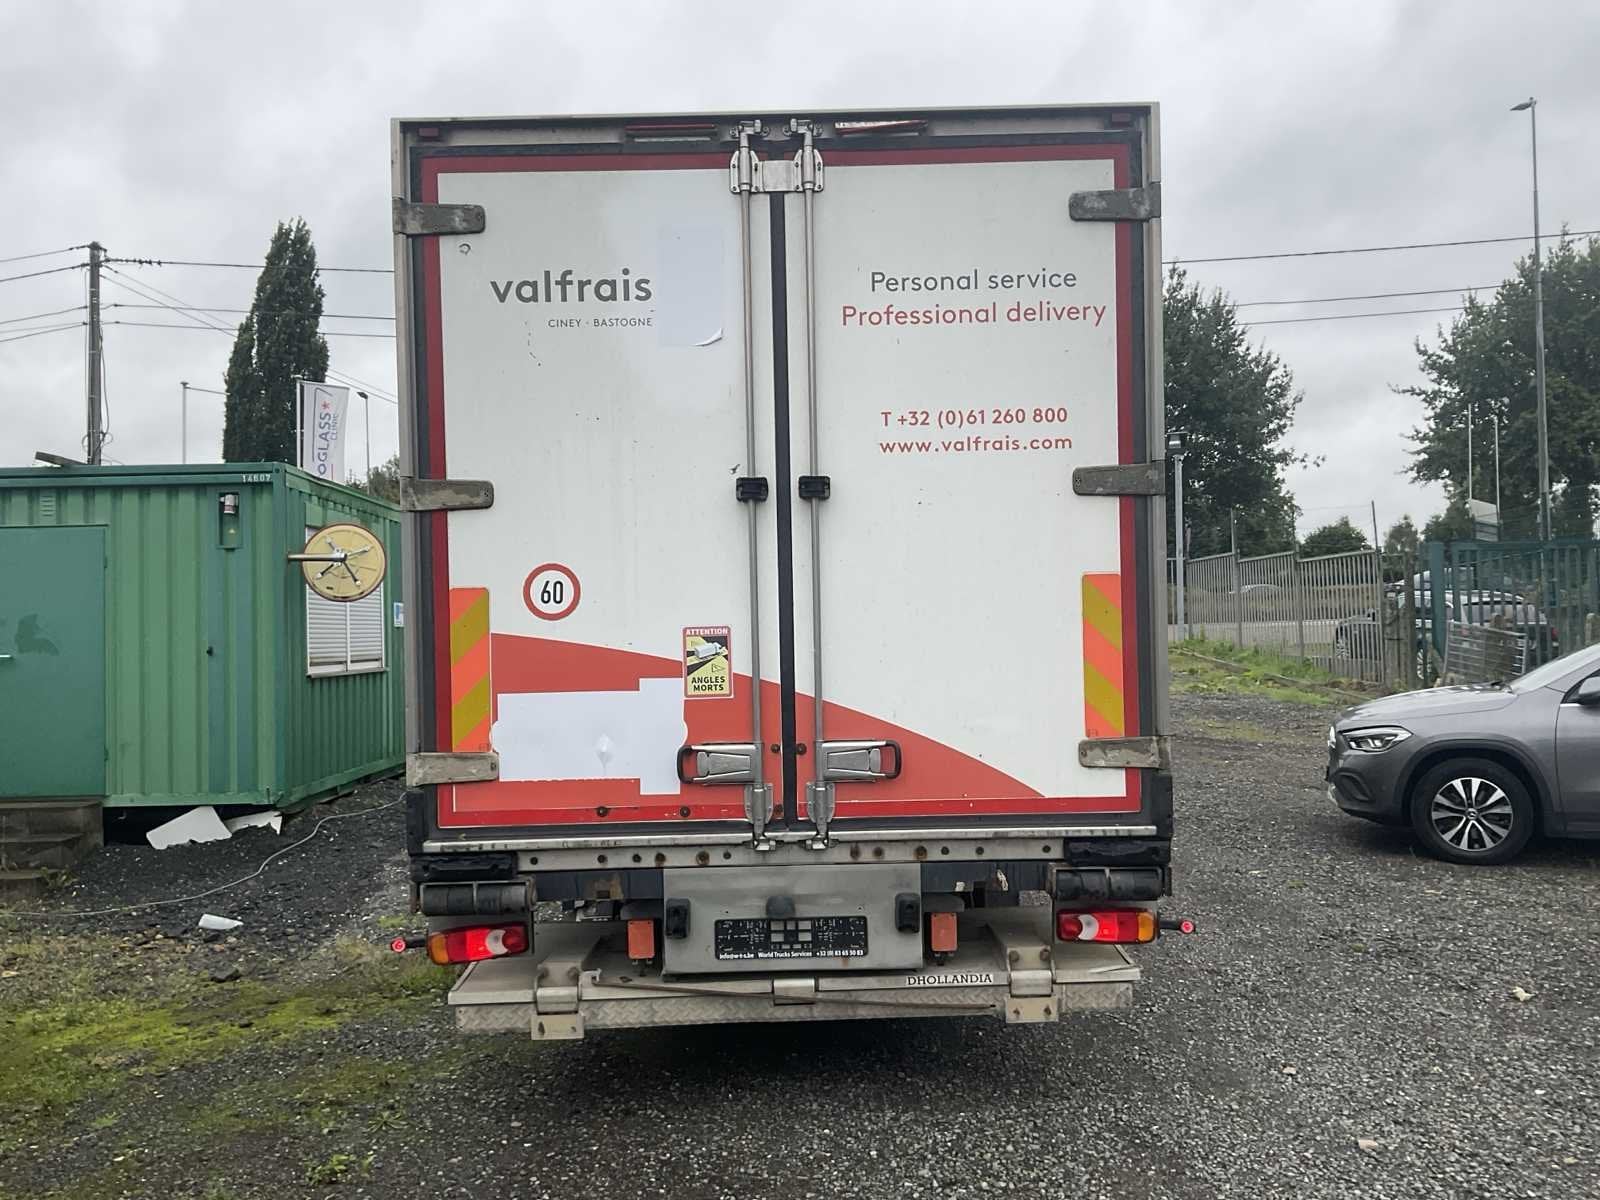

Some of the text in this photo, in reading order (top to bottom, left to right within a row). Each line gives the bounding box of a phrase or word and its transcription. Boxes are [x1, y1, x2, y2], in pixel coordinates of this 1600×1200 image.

[490, 268, 653, 303] valfrais
[870, 268, 1078, 292] Personal service
[842, 300, 1107, 327] Professional delivery
[547, 317, 653, 329] CINEY BASTOGNE
[880, 407, 1068, 429] T +32 (0)61 260 800
[879, 435, 1073, 453] www.valfrais.com
[540, 580, 564, 604] 60
[685, 627, 728, 636] ATTENTION
[691, 675, 726, 684] ANGLES
[693, 684, 724, 692] MORTS
[757, 951, 774, 959] World
[907, 973, 993, 986] DHOLLANDIA
